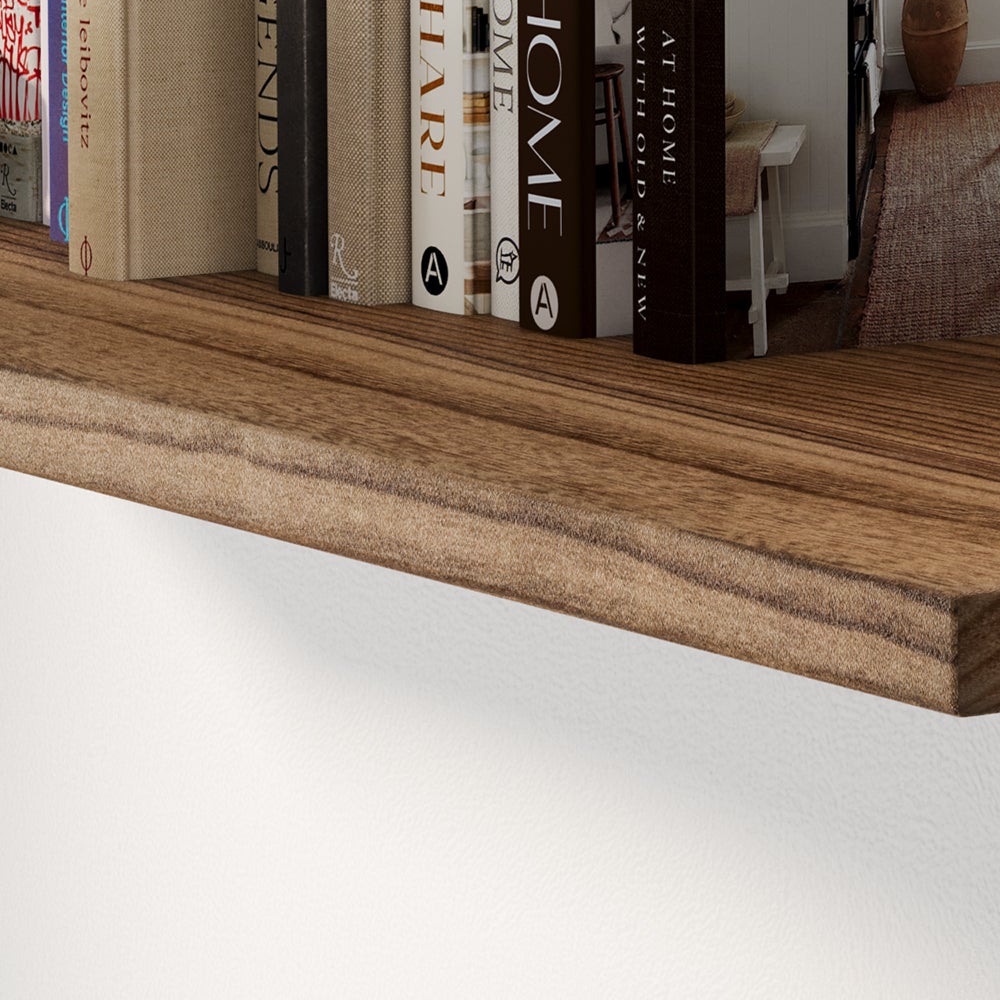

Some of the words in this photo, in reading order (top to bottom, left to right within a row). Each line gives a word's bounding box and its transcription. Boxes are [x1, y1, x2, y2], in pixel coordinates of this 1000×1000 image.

[80, 18, 92, 149] leibovitz
[635, 25, 647, 119] WITH
[661, 29, 676, 72] AT
[635, 131, 648, 200] OLD
[661, 87, 676, 186] HOME
[636, 212, 647, 231] &
[636, 246, 648, 322] NEW
